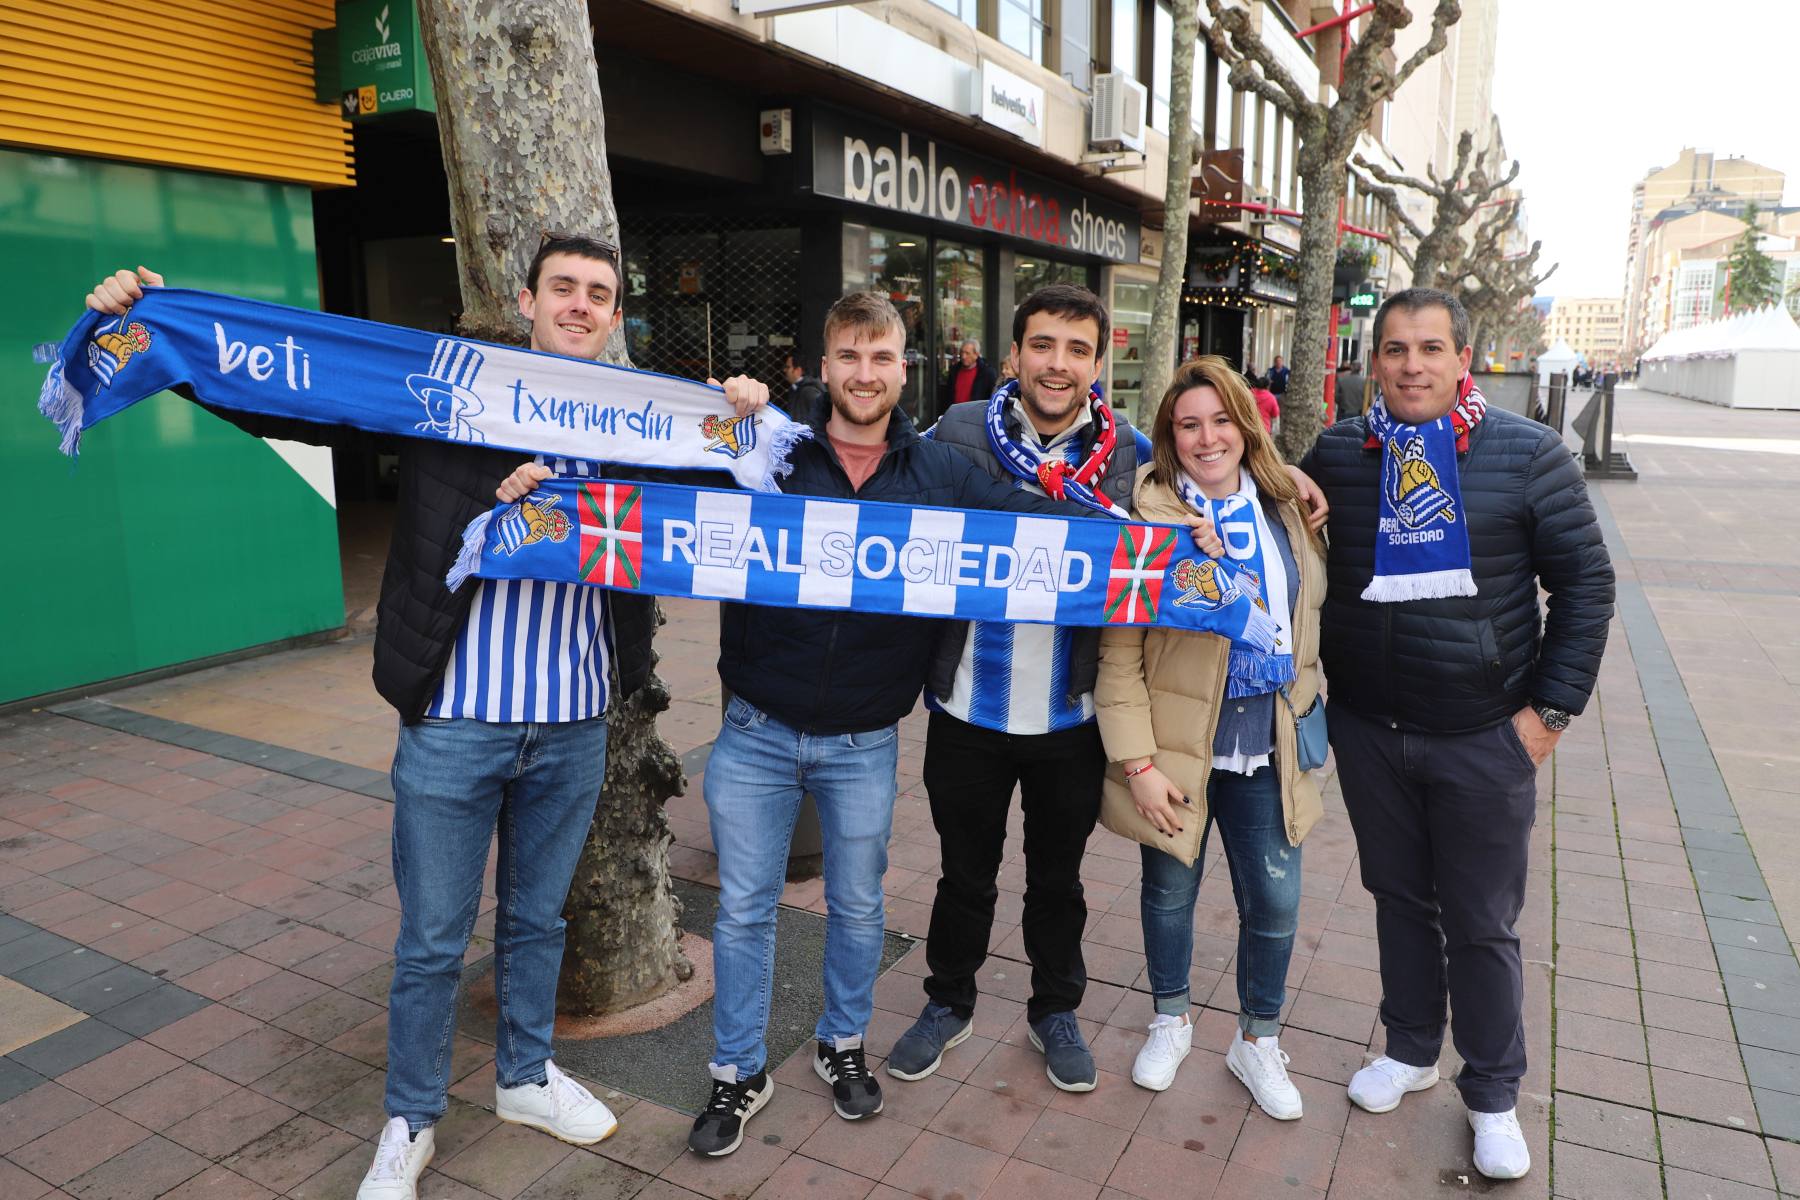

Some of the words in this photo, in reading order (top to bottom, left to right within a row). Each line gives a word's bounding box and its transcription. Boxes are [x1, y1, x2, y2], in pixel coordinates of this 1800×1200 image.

[352, 42, 402, 65] cajaviva
[380, 88, 414, 104] CAJERO
[843, 132, 962, 223] pablo
[1071, 198, 1127, 261] shoes
[213, 321, 311, 391] beti
[506, 378, 674, 441] txuriurdin
[1378, 517, 1401, 533] REAL
[1388, 529, 1445, 545] SOCIEDAD
[662, 518, 807, 575] REAL
[819, 531, 1093, 593] SOCIEDAD
